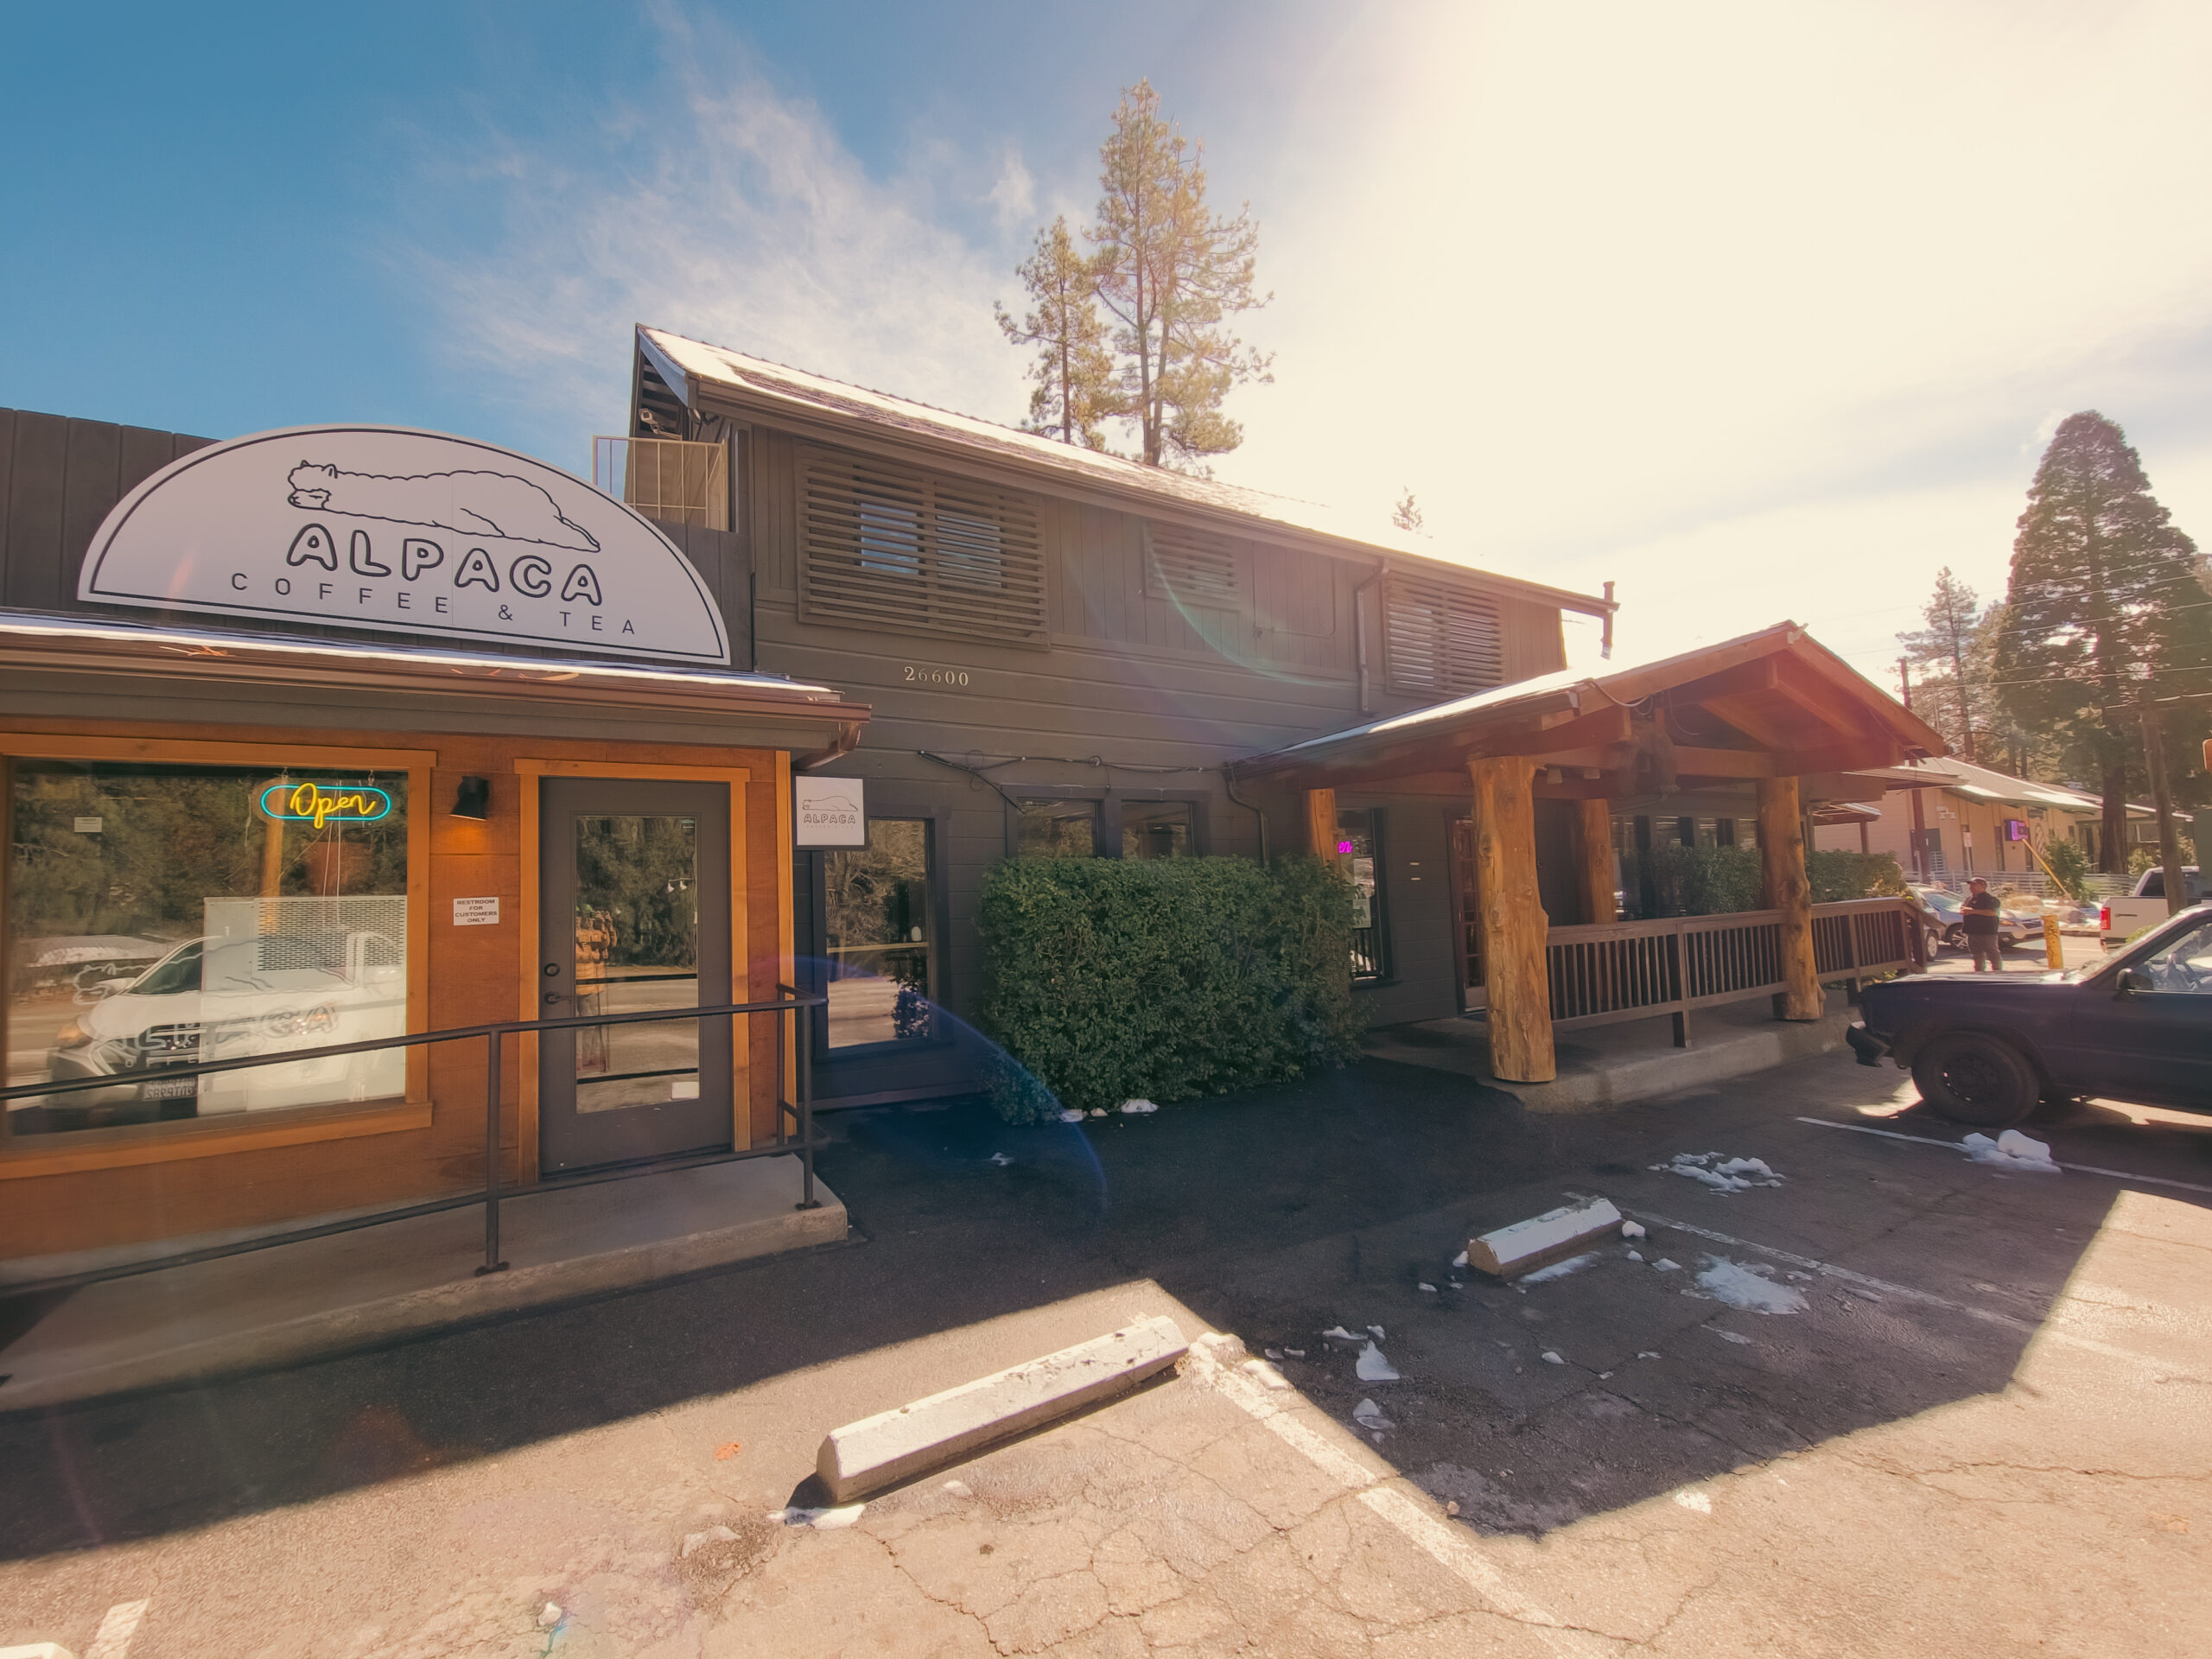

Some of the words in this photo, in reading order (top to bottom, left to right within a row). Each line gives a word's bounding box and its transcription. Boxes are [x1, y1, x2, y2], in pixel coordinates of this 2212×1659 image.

[286, 523, 602, 607] ALPACA
[232, 573, 448, 613] COFFEE
[498, 604, 513, 621] &
[559, 611, 635, 635] TEA
[904, 666, 969, 686] 26600
[289, 782, 377, 830] Open
[804, 813, 856, 824] ALPACA
